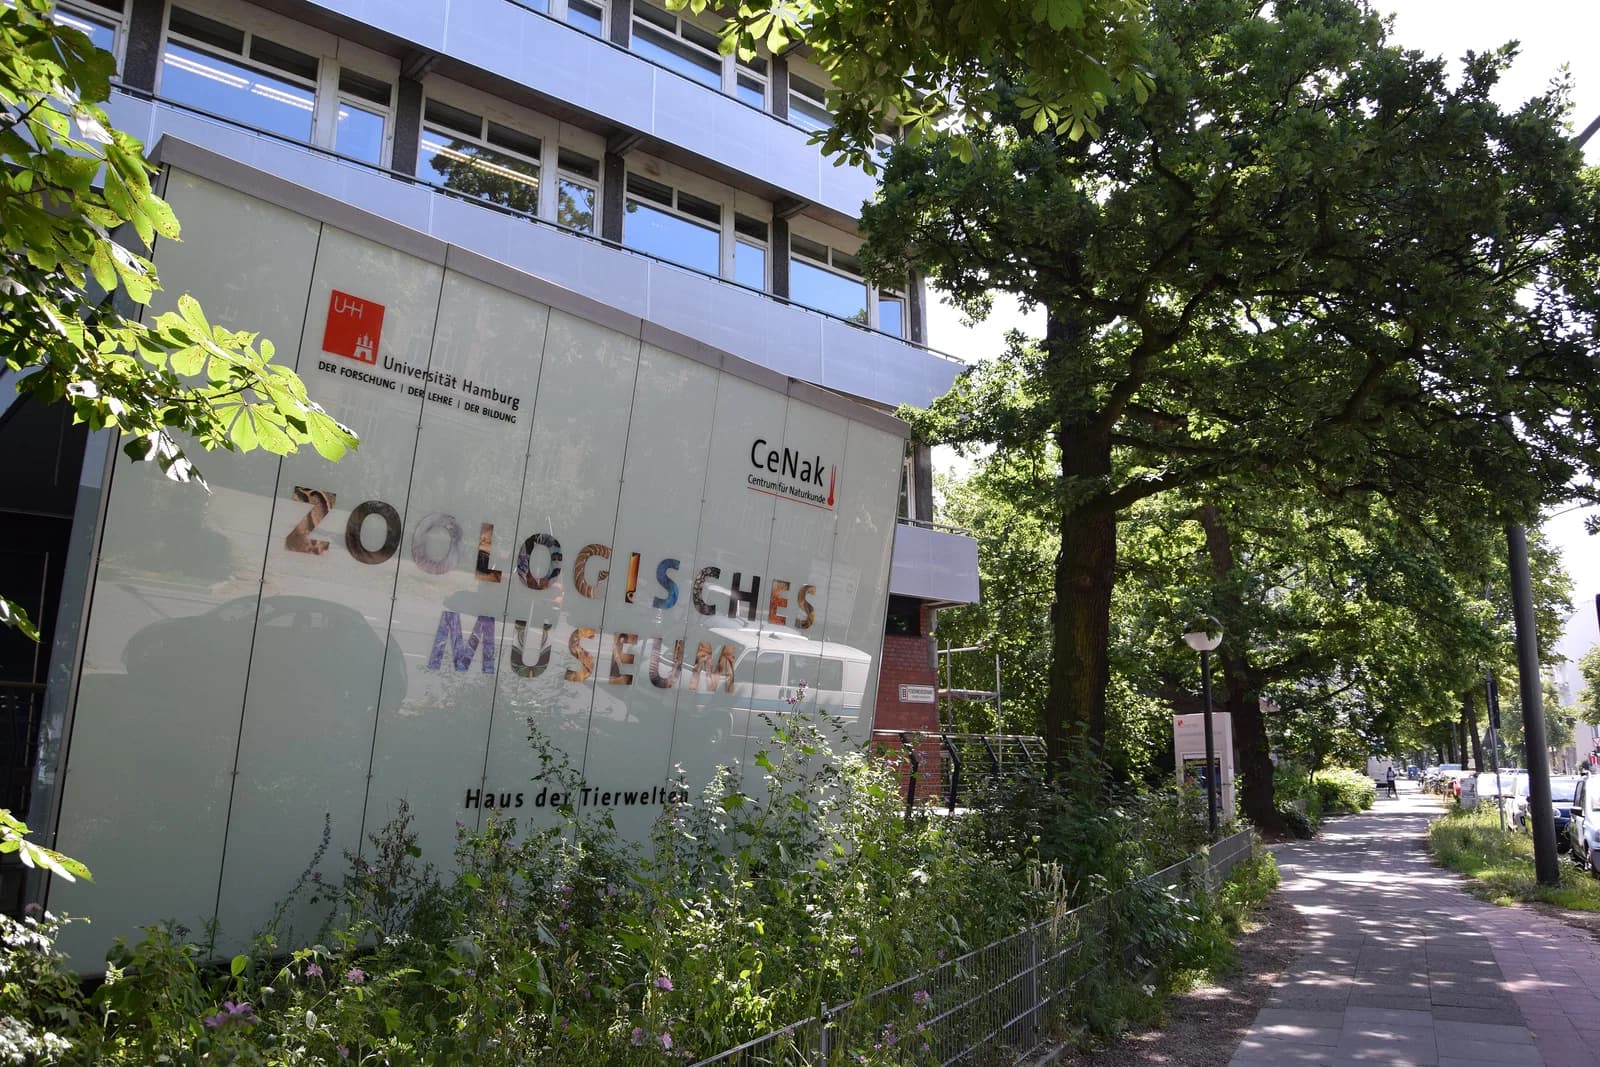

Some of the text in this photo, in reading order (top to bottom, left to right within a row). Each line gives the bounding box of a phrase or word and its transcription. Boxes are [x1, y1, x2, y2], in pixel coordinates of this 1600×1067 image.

[318, 360, 517, 424] DER FORSCHUNG DER LEHRE DER BILDUNG
[383, 355, 521, 411] Universität Hamburg
[747, 474, 826, 504] Centrum für Naturkunde
[751, 439, 825, 487] CeNak
[285, 486, 817, 630] ZOOLOGISCHES
[428, 611, 737, 693] MUSEUM
[465, 788, 524, 809] Haus
[535, 786, 572, 808] der
